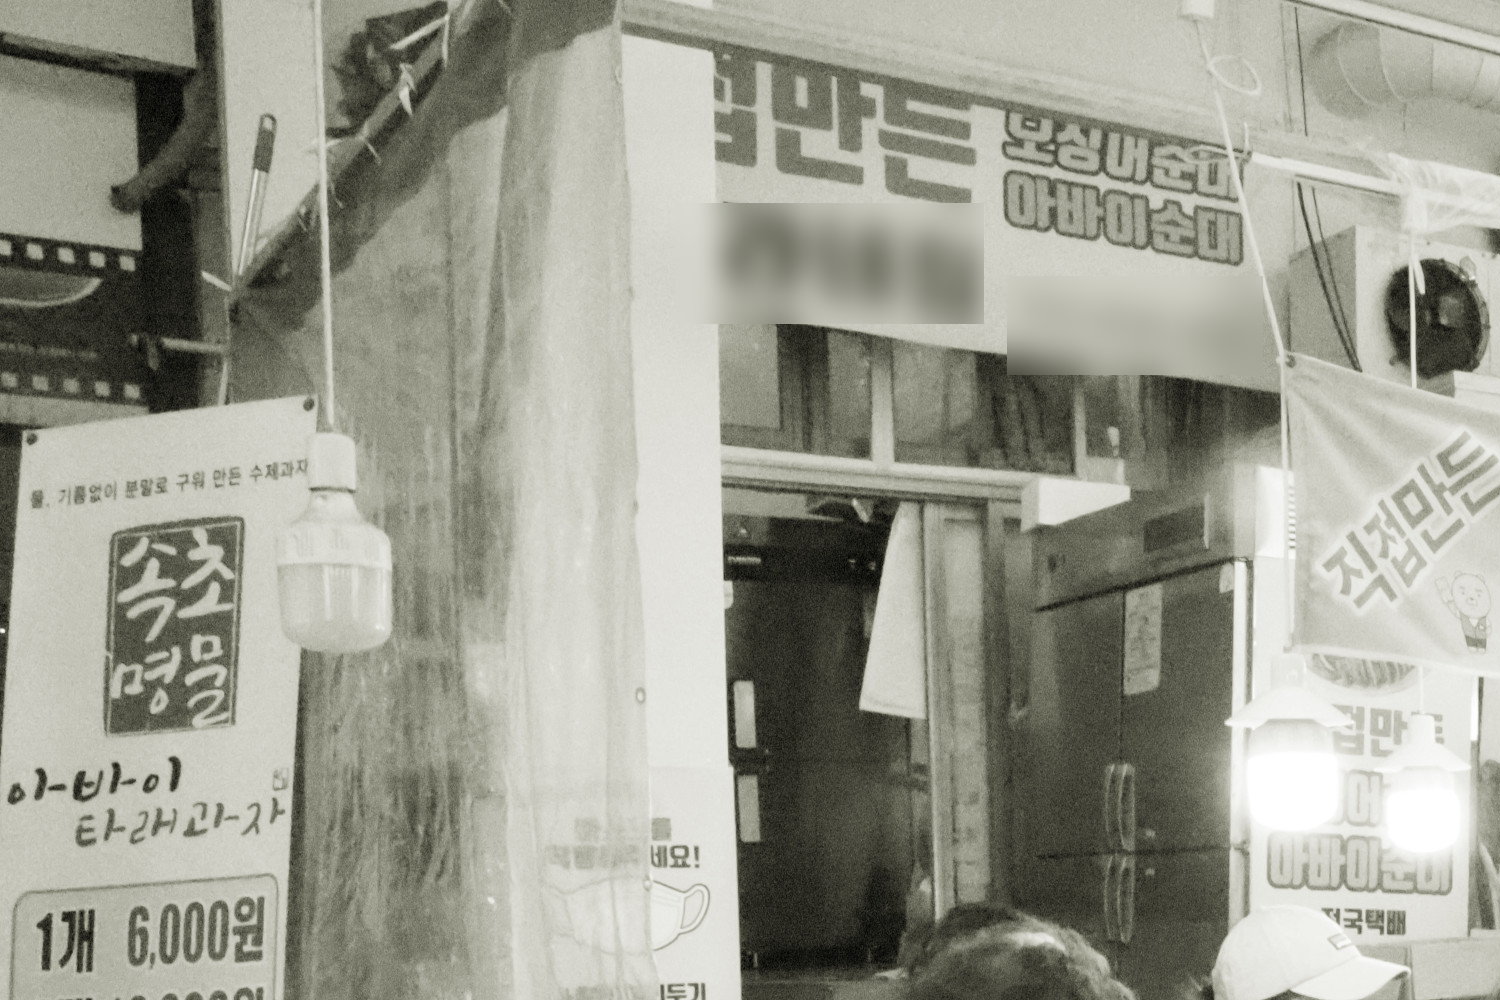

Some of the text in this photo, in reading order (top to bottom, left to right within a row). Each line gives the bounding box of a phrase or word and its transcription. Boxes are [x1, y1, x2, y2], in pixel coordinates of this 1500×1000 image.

[1002, 170, 1243, 267] 아바이순대
[212, 466, 242, 488] 만든
[8, 756, 182, 806] 아바이
[75, 797, 287, 847] 타래과자
[36, 896, 265, 973] 1개 6,000원
